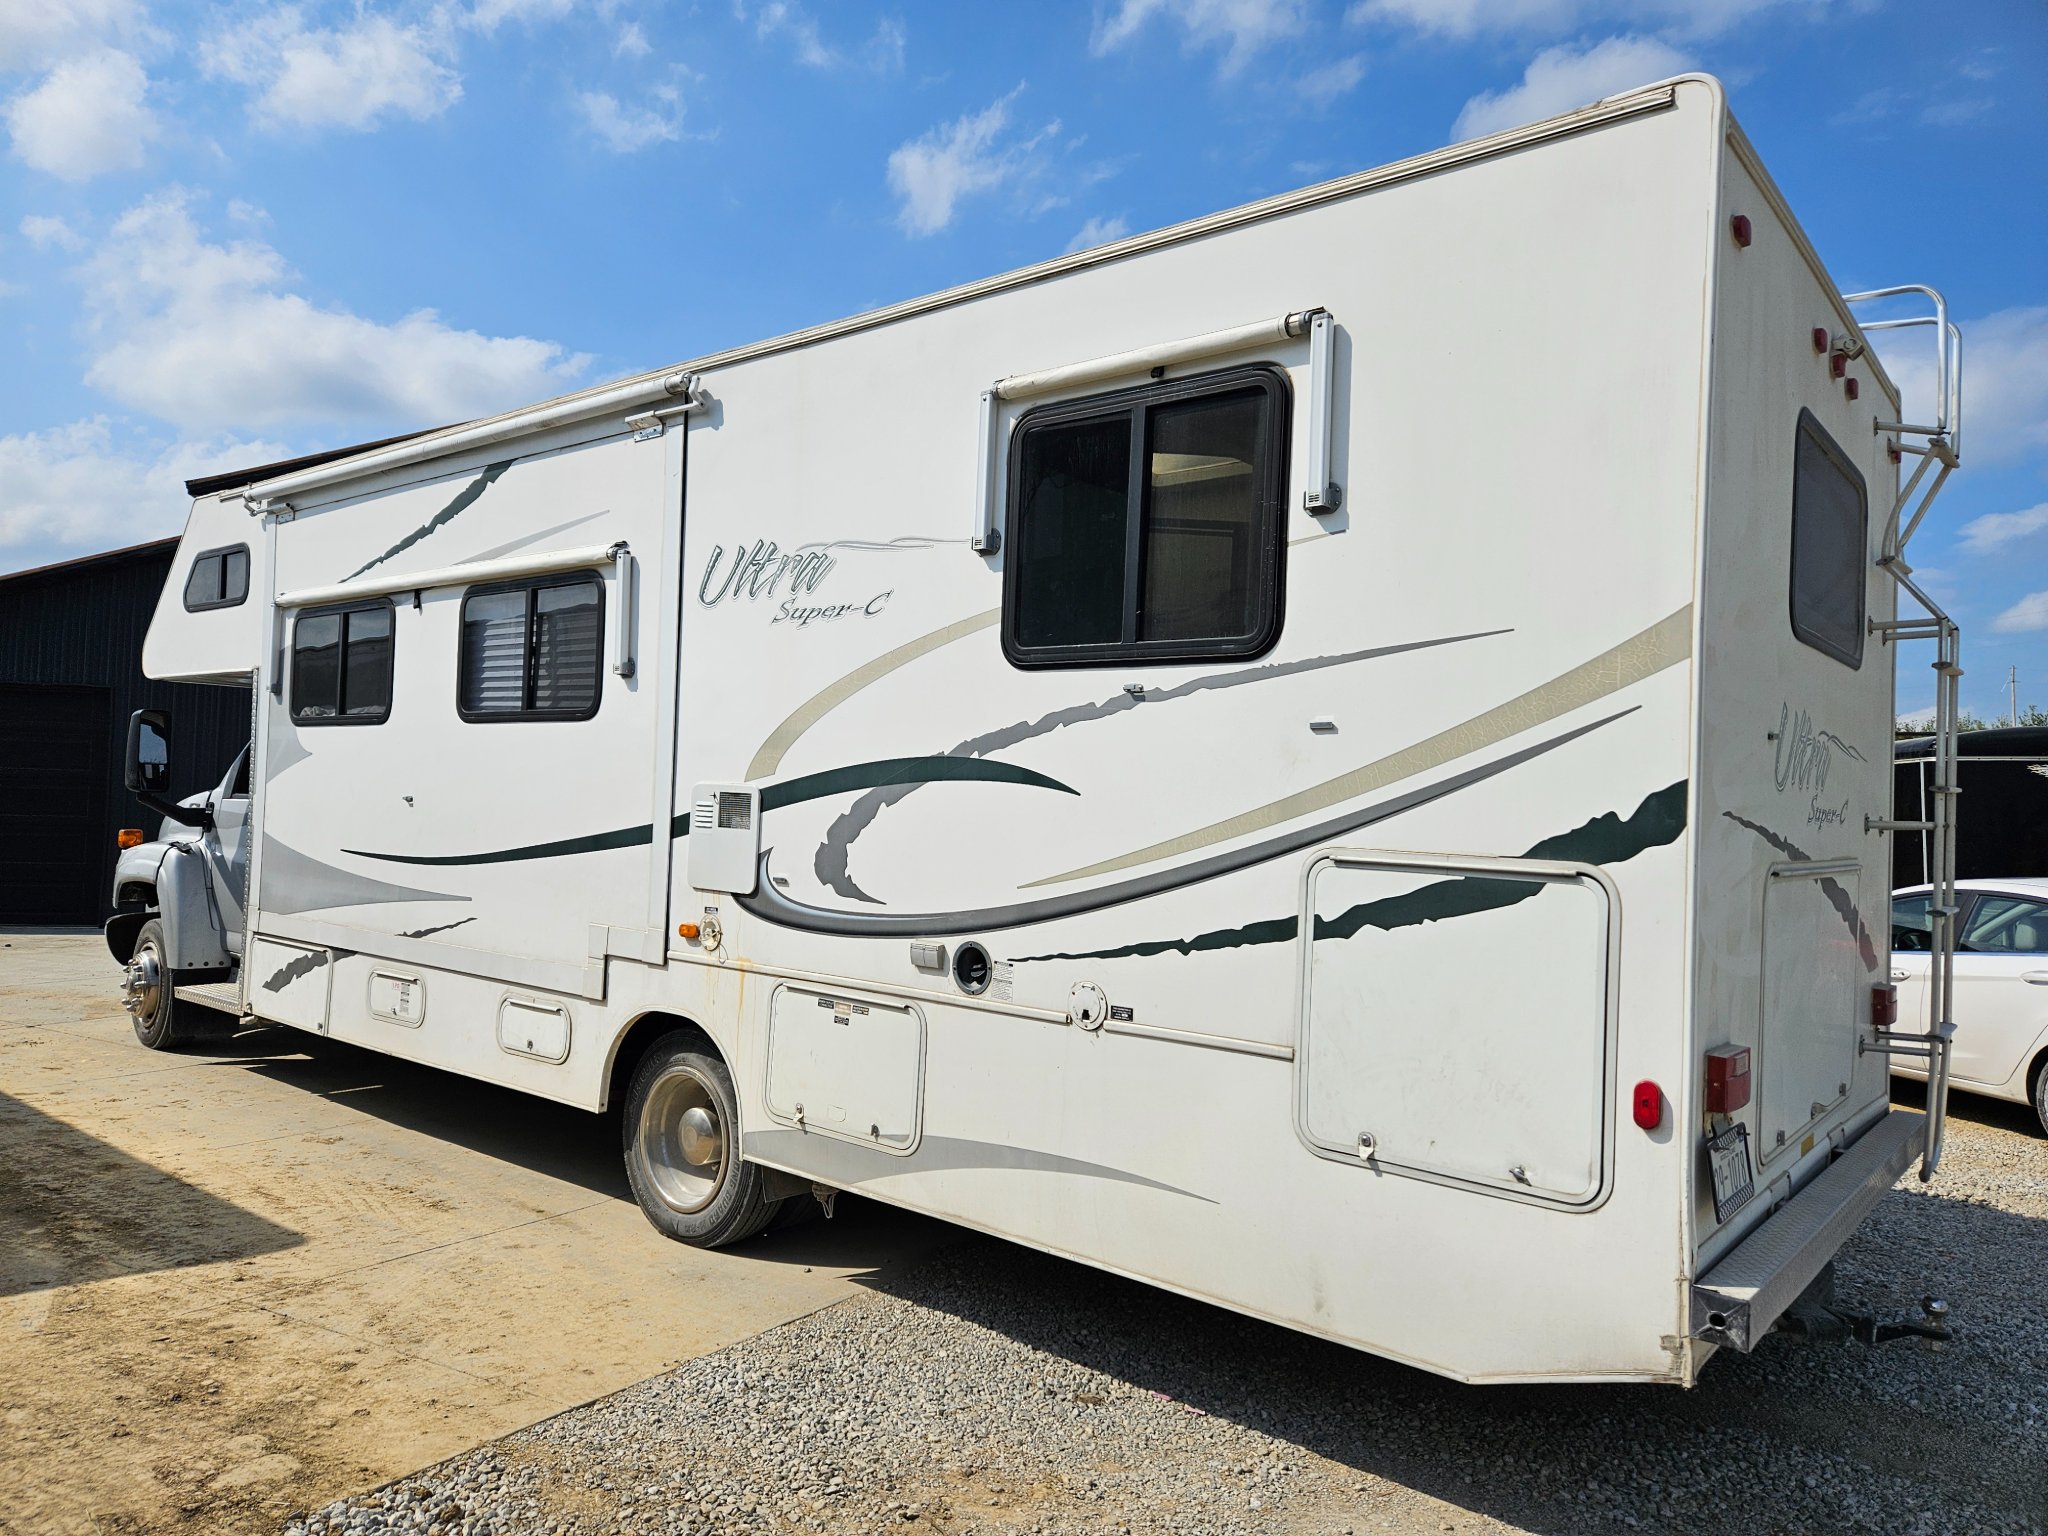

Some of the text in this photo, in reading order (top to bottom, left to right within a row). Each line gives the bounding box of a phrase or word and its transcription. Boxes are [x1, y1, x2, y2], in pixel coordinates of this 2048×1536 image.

[699, 539, 836, 607] Ultra
[771, 588, 893, 629] Super-C
[1775, 700, 1831, 792] Ultra
[1807, 794, 1849, 831] Super-C
